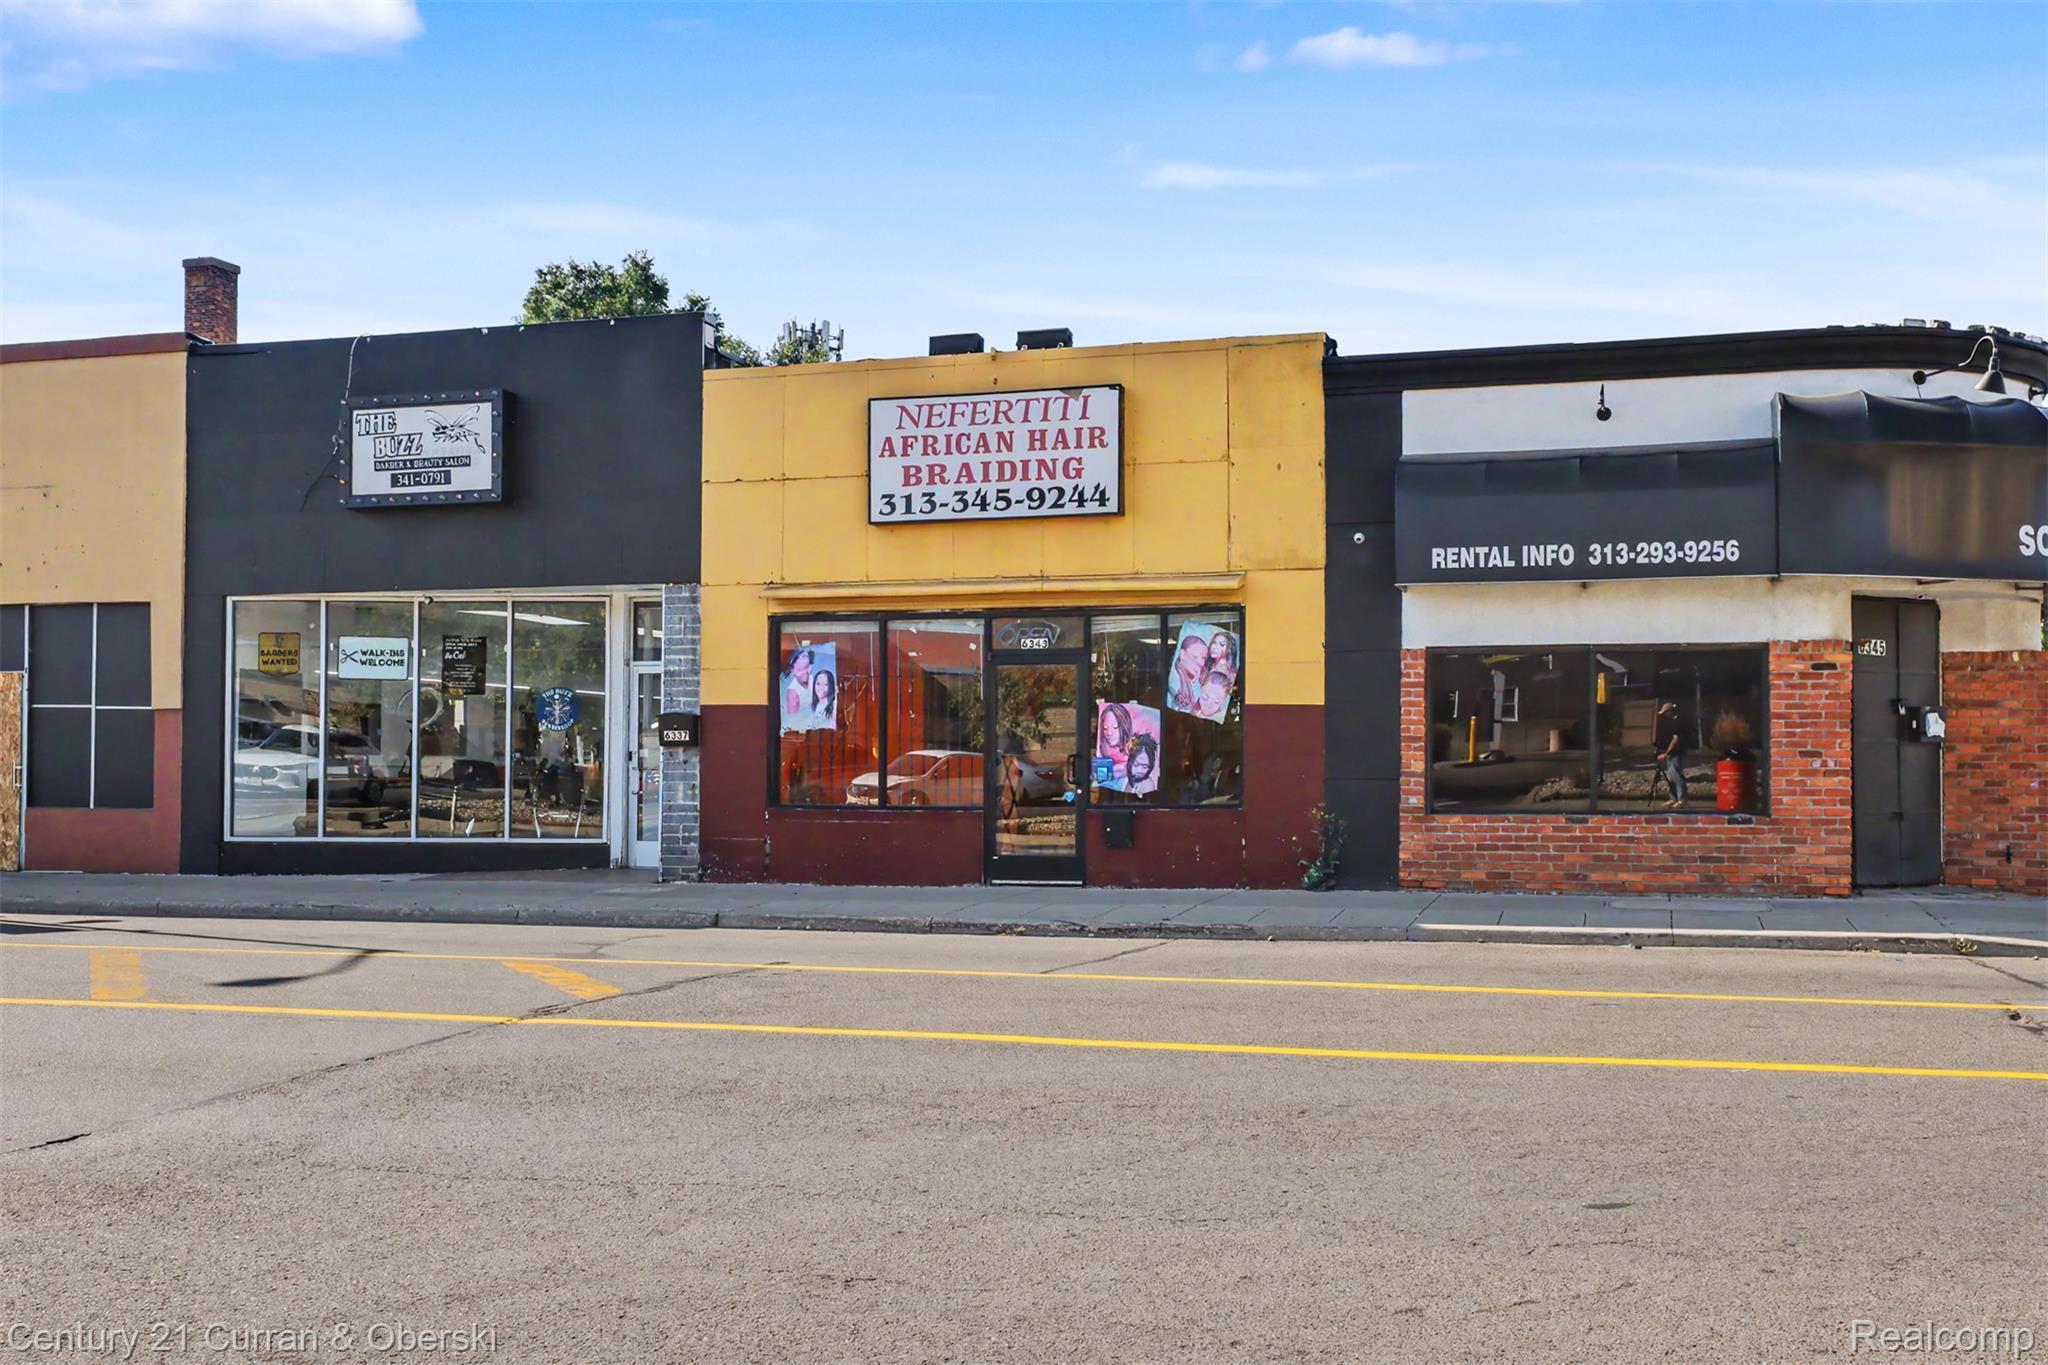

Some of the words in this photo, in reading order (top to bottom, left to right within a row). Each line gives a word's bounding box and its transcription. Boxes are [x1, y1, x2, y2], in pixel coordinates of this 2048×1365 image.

[896, 393, 1091, 430] NEFERTITI
[355, 411, 397, 436] THE
[374, 433, 423, 459] BUZZ
[879, 431, 1015, 458] AFRICAN
[1027, 426, 1109, 452] HAIR
[414, 458, 443, 468] BEAUTY
[444, 456, 470, 466] SALON
[901, 456, 1085, 487] BRAIDING
[396, 472, 445, 486] 341-0791
[878, 482, 1110, 516] 313-345-9244
[1431, 546, 1515, 569] RENTAL
[1522, 544, 1575, 567] INFO
[1588, 539, 1740, 565] 313-293-9256
[261, 649, 298, 657] BARBERS
[262, 658, 297, 666] WANTED
[360, 649, 405, 657] WALK-INS
[360, 658, 405, 666] WELCOME
[665, 731, 688, 740] 6337
